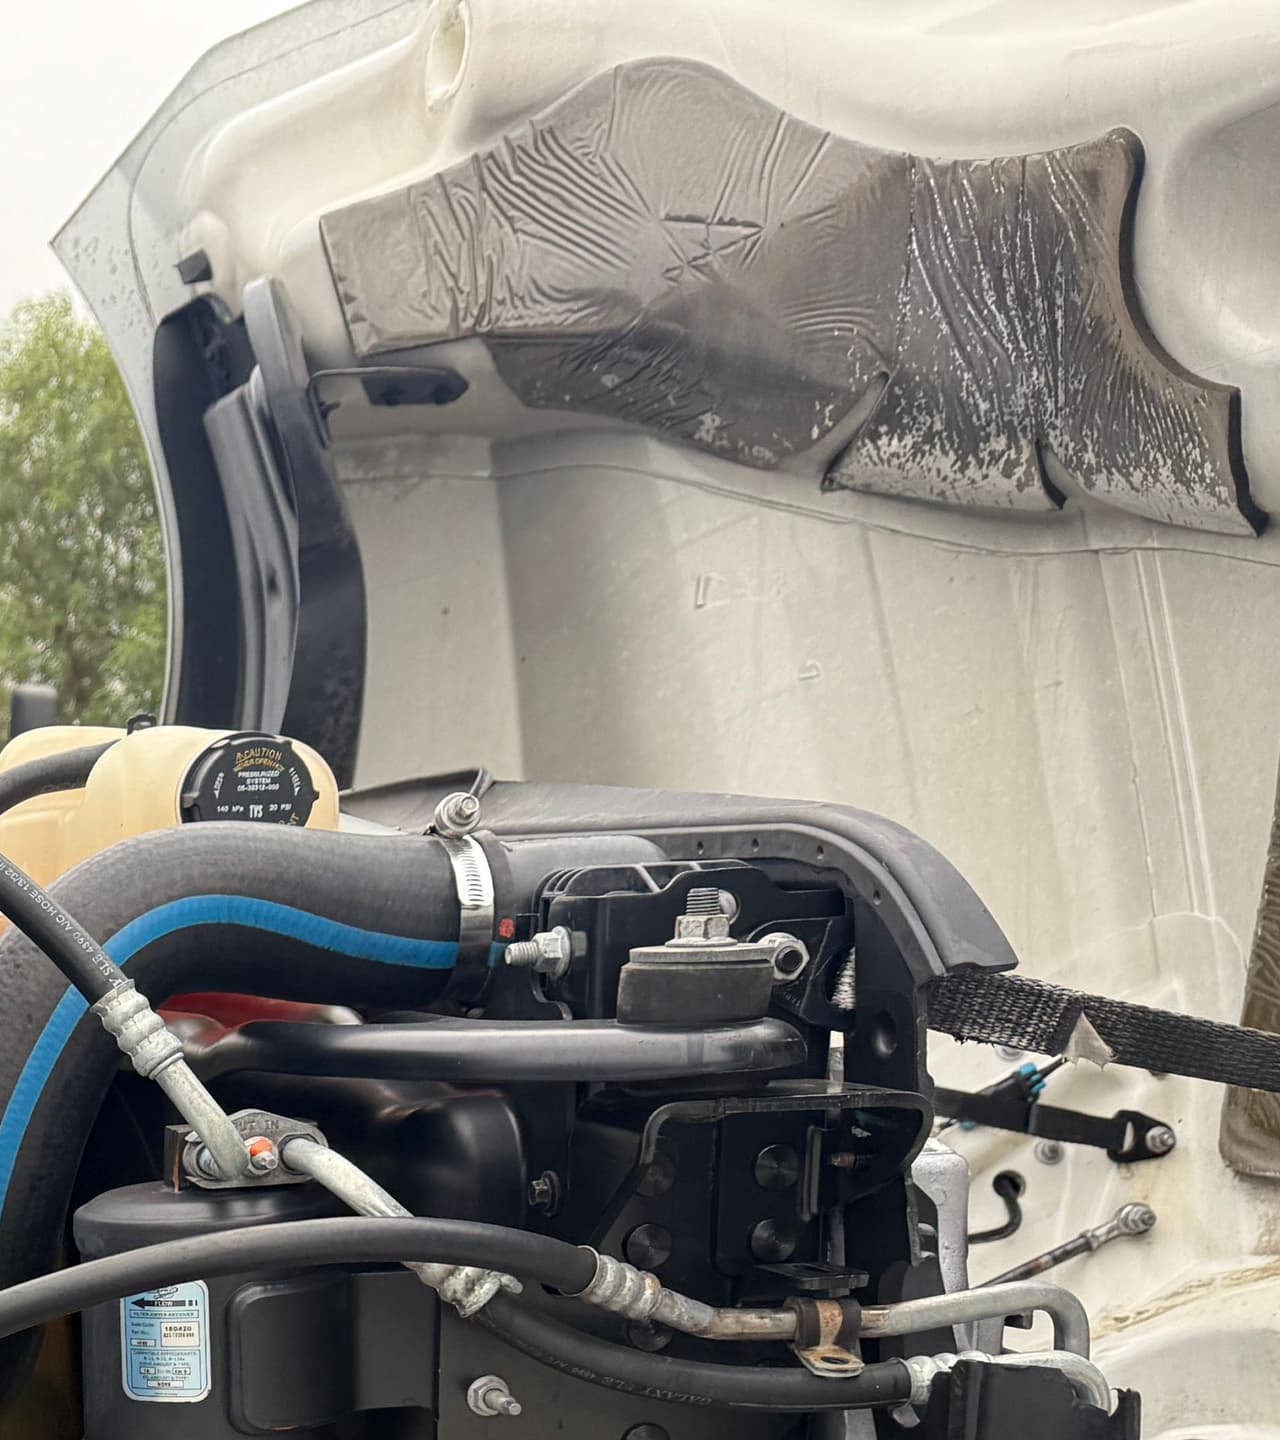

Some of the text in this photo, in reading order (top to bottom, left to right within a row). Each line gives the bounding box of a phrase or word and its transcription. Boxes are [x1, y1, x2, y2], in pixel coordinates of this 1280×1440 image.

[243, 747, 283, 761] CAUTION
[246, 777, 272, 785] SYSTEM
[249, 804, 264, 819] TVS
[280, 803, 293, 811] PSI
[28, 889, 58, 916] HOSE
[91, 953, 115, 977] SLE
